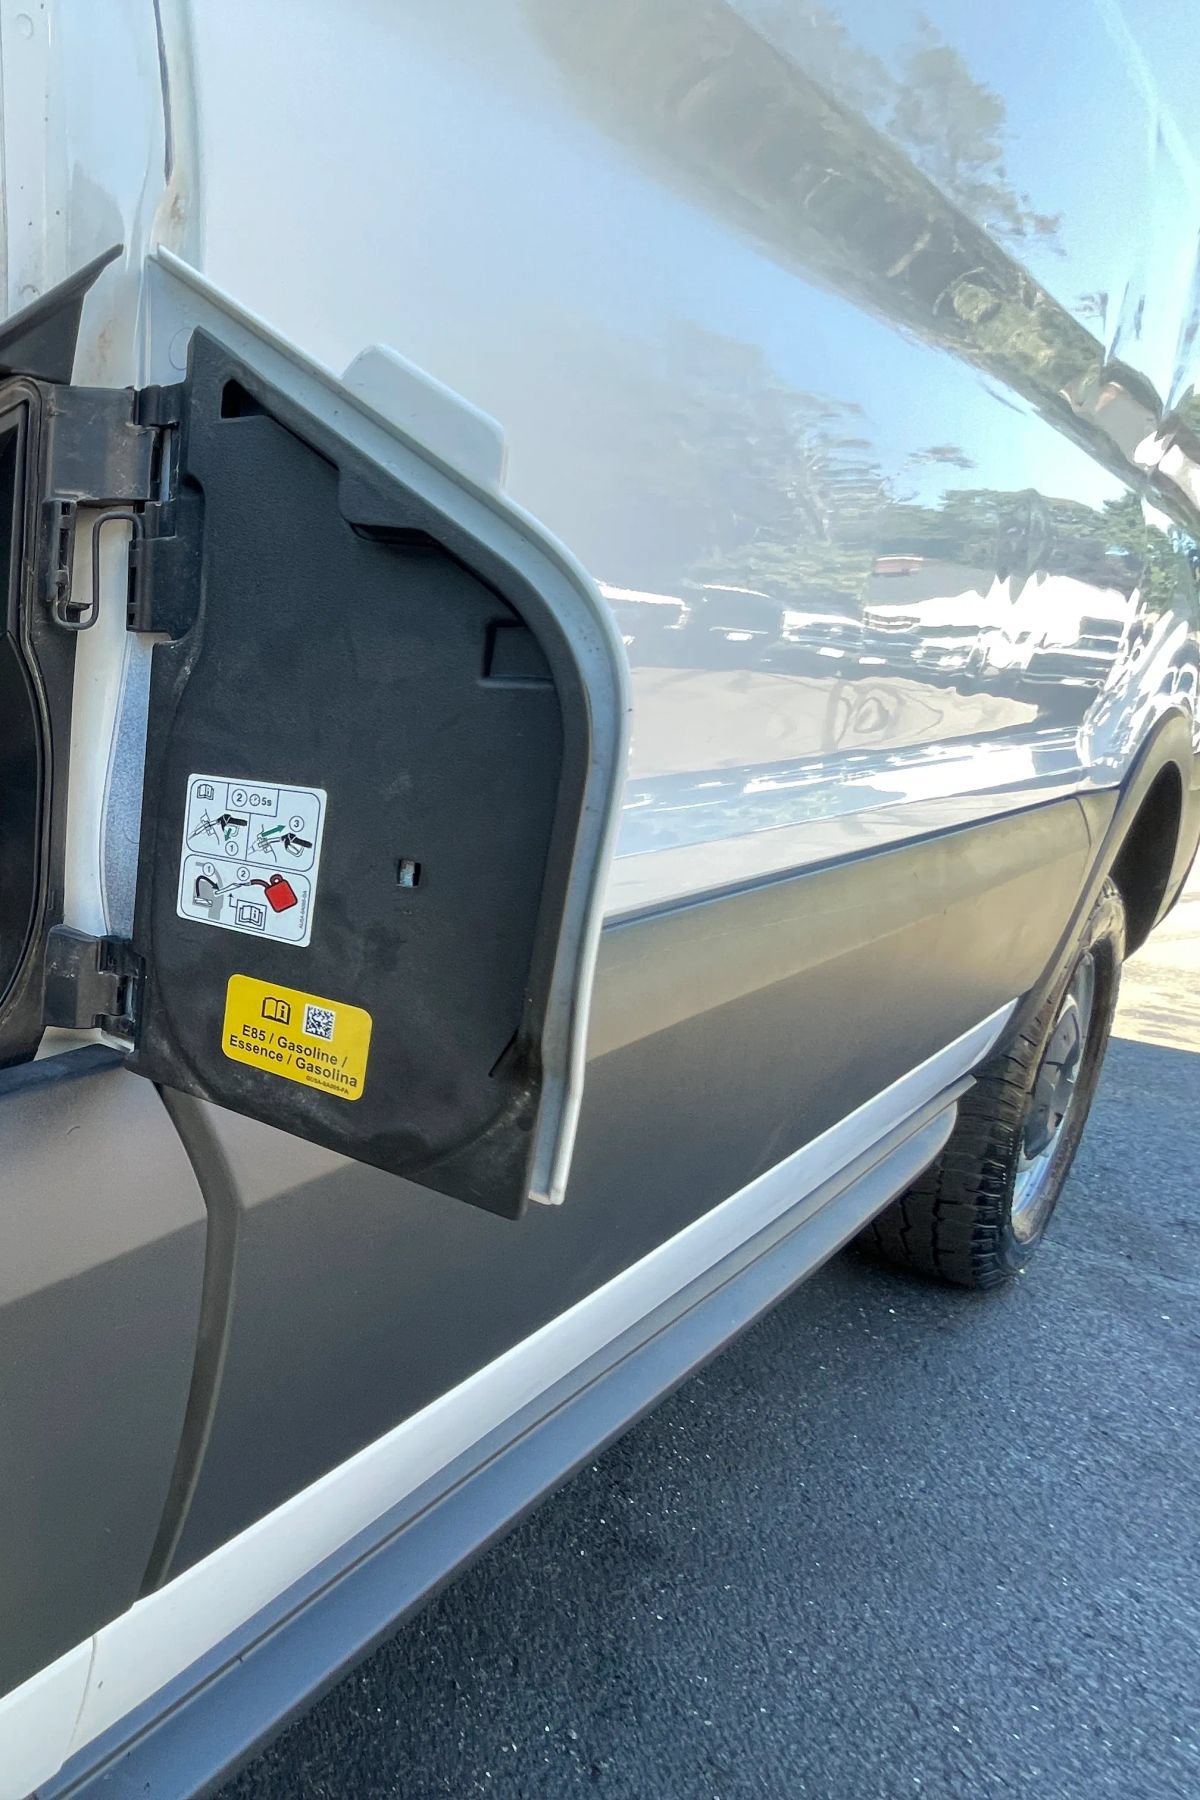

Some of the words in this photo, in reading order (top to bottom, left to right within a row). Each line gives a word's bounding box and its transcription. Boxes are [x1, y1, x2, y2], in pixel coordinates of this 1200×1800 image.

[260, 797, 273, 807] 5s
[229, 1034, 284, 1063] Essence
[286, 1053, 293, 1065] /
[295, 1057, 359, 1088] Gasolina
[242, 1023, 267, 1042] E85
[268, 1032, 275, 1045] /
[277, 1036, 339, 1066] Gasoline
[341, 1055, 348, 1068] /
